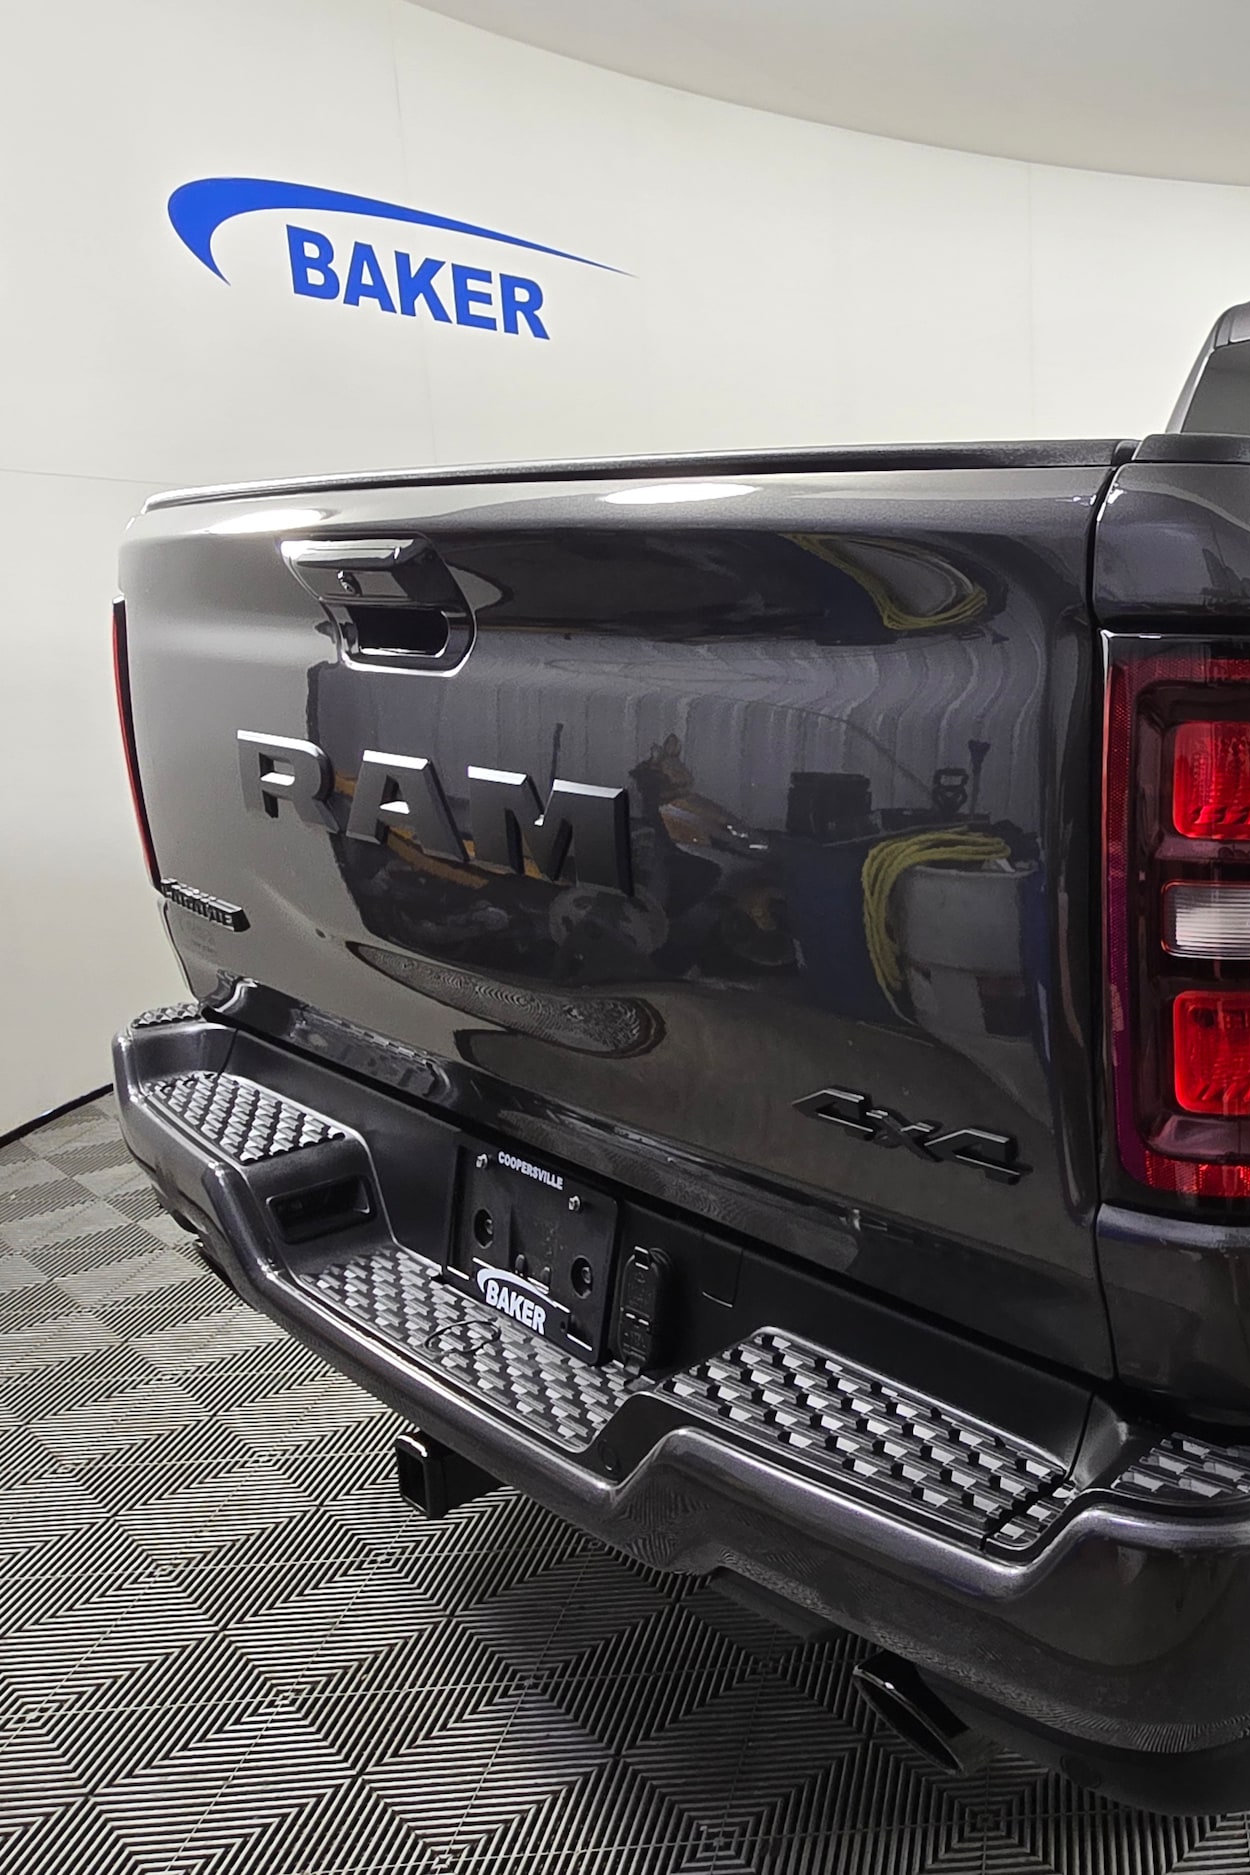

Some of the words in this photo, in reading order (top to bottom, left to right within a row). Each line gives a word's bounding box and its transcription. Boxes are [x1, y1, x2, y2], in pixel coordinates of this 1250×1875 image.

[286, 224, 550, 340] BAKER
[237, 729, 635, 897] RAM
[498, 1151, 564, 1190] COOPERSVILLE
[486, 1281, 546, 1334] BAKER
